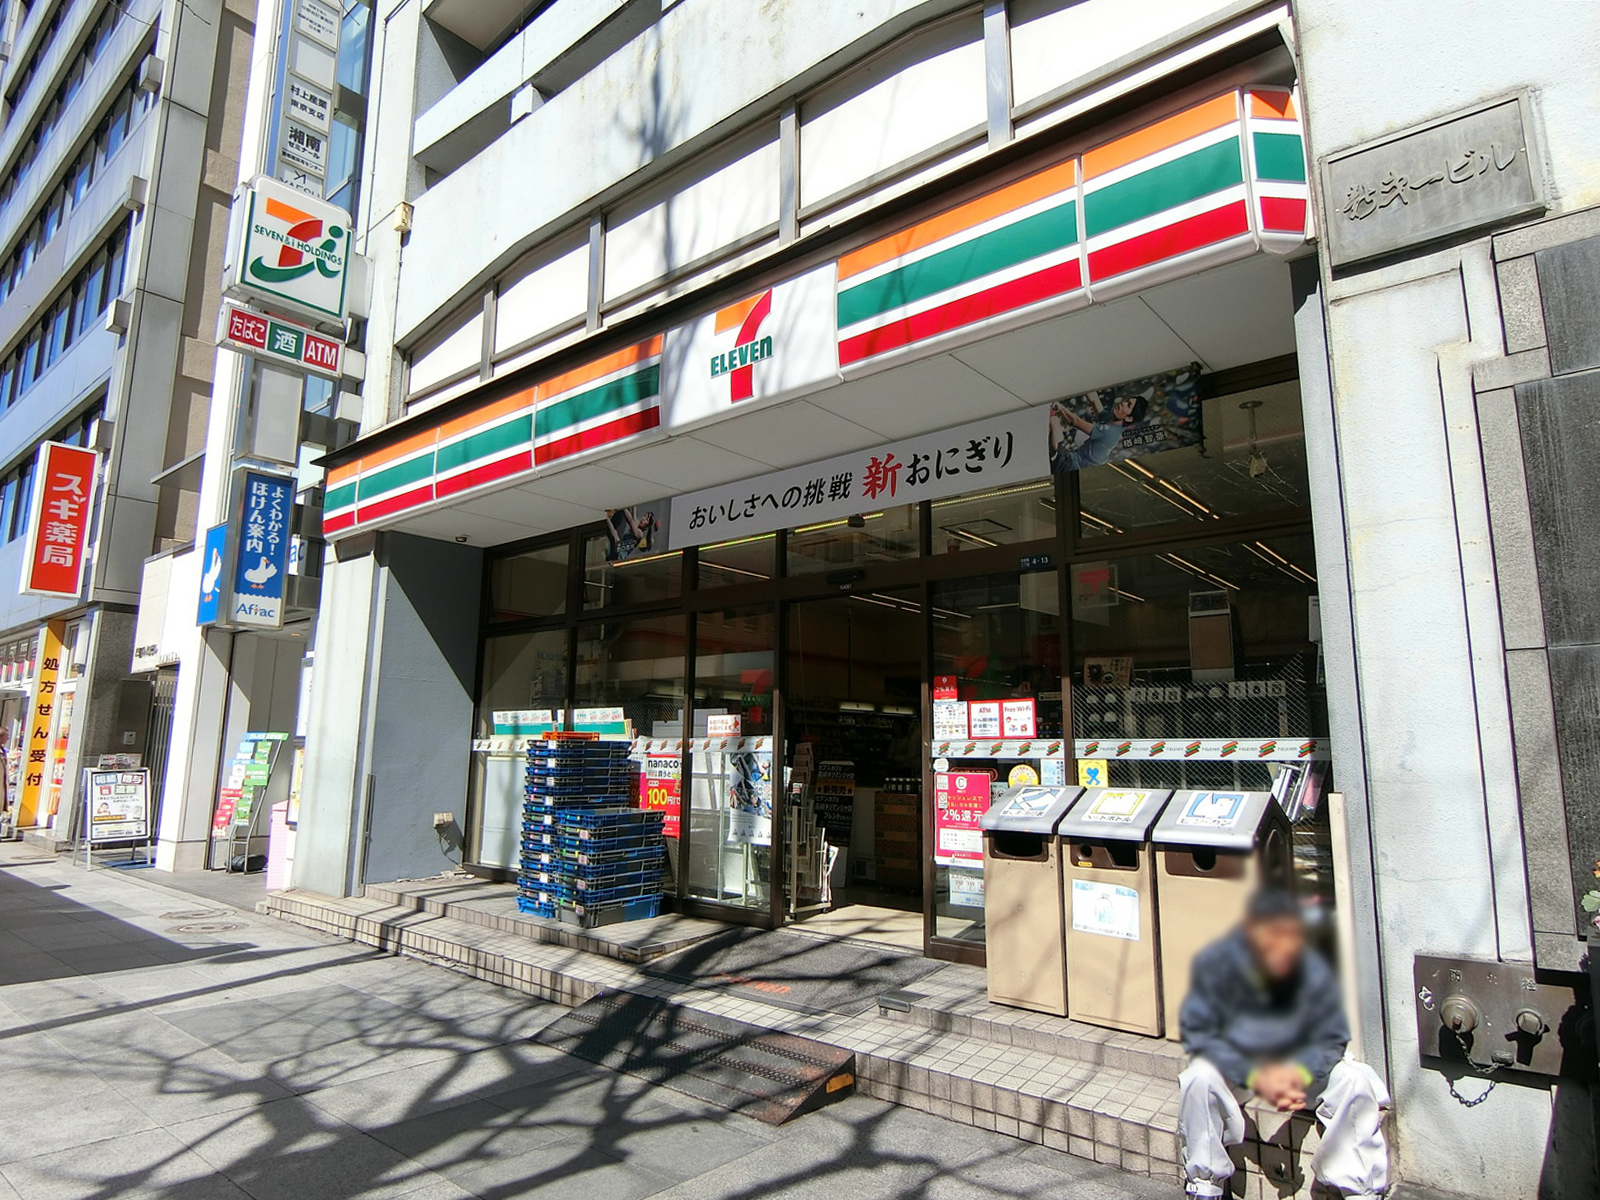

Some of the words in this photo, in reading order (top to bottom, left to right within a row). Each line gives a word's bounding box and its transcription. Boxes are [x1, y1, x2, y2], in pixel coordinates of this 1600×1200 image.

[288, 126, 321, 153] 湘南
[296, 242, 342, 266] HOLDINGS
[230, 315, 266, 344] たばこ
[274, 328, 298, 354] 酒
[306, 340, 336, 367] ATM
[688, 472, 853, 530] おいしさへの挑戦
[42, 473, 87, 568] スギ薬局
[246, 481, 269, 553] ほけん案内
[26, 657, 59, 787] 処方せん受付
[647, 759, 679, 769] nanaco
[942, 808, 984, 822] 2%還元
